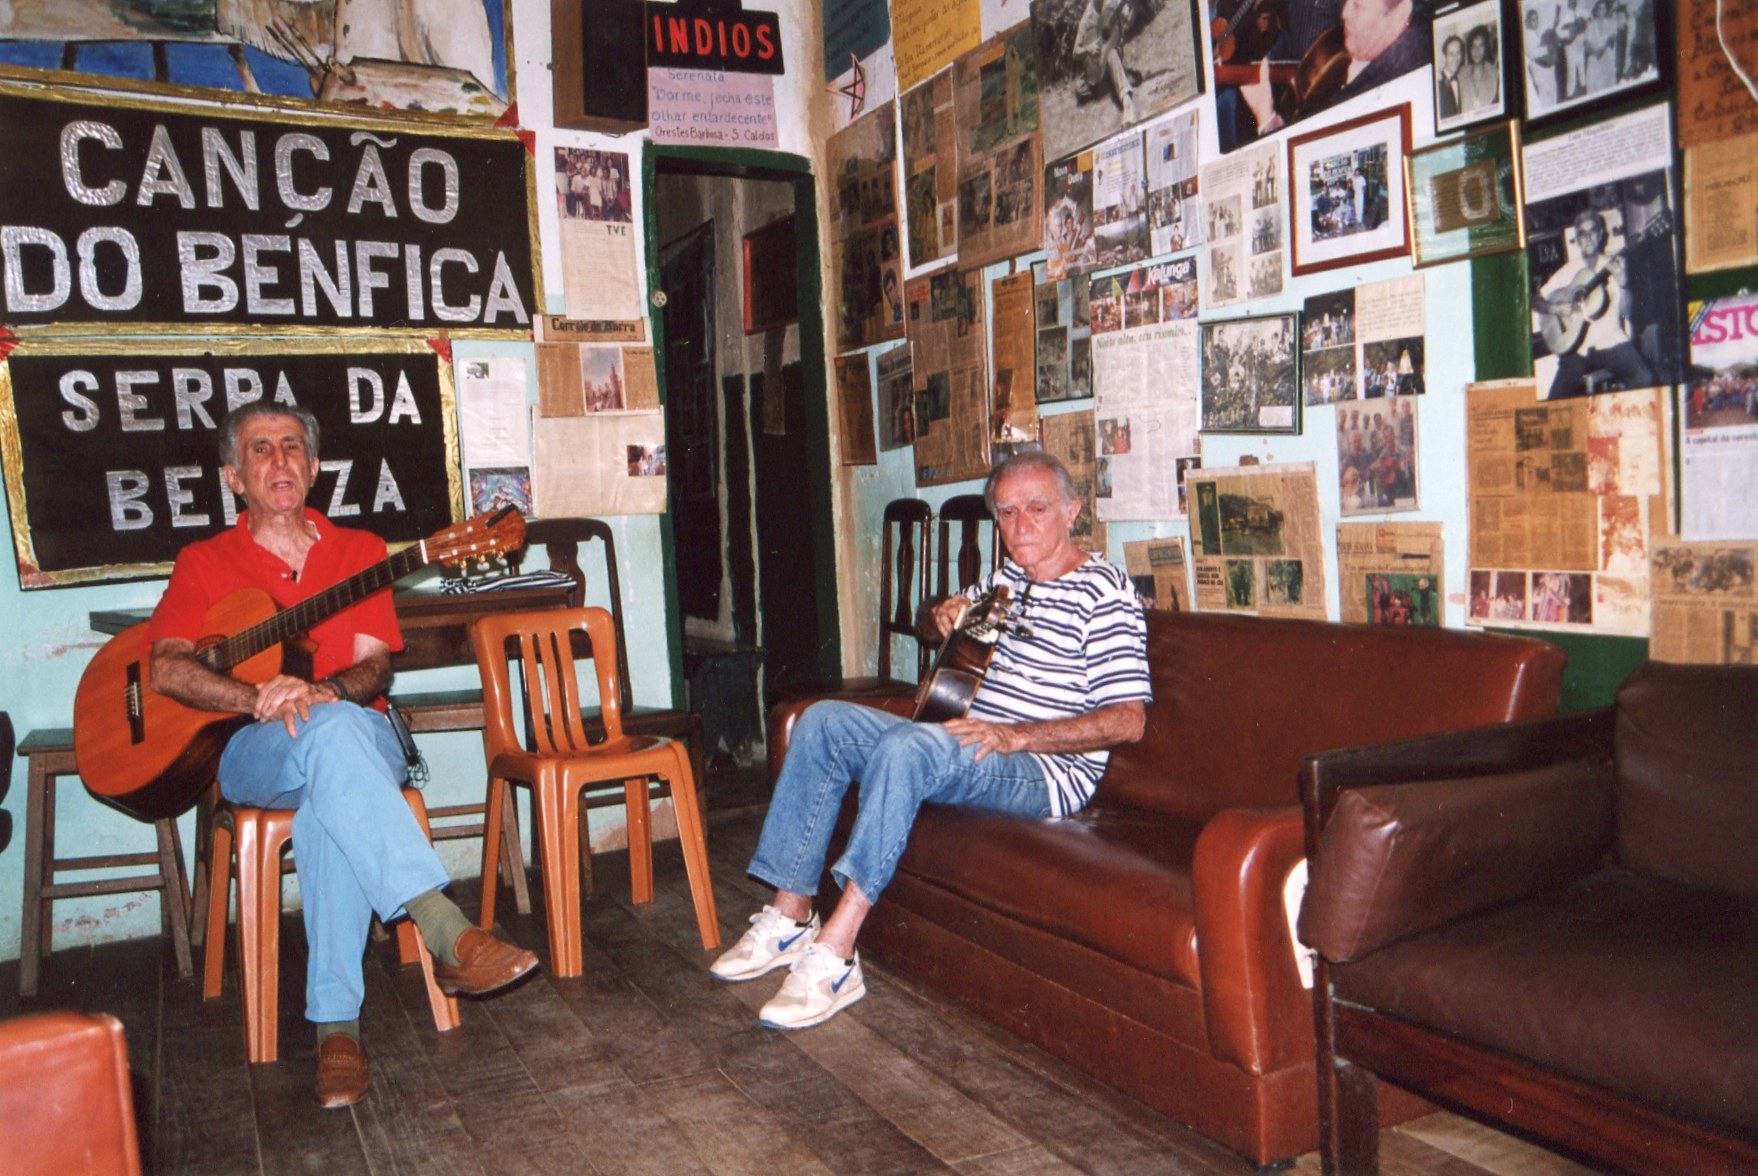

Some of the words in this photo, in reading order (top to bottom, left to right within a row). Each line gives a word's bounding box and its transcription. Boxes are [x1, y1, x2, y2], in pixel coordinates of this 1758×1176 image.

[654, 15, 774, 60] INDIOS
[60, 120, 461, 228] CANÇÃO
[606, 224, 627, 236] TVE
[2, 225, 144, 314] DO
[346, 366, 423, 426] DA
[106, 457, 407, 532] BELZA
